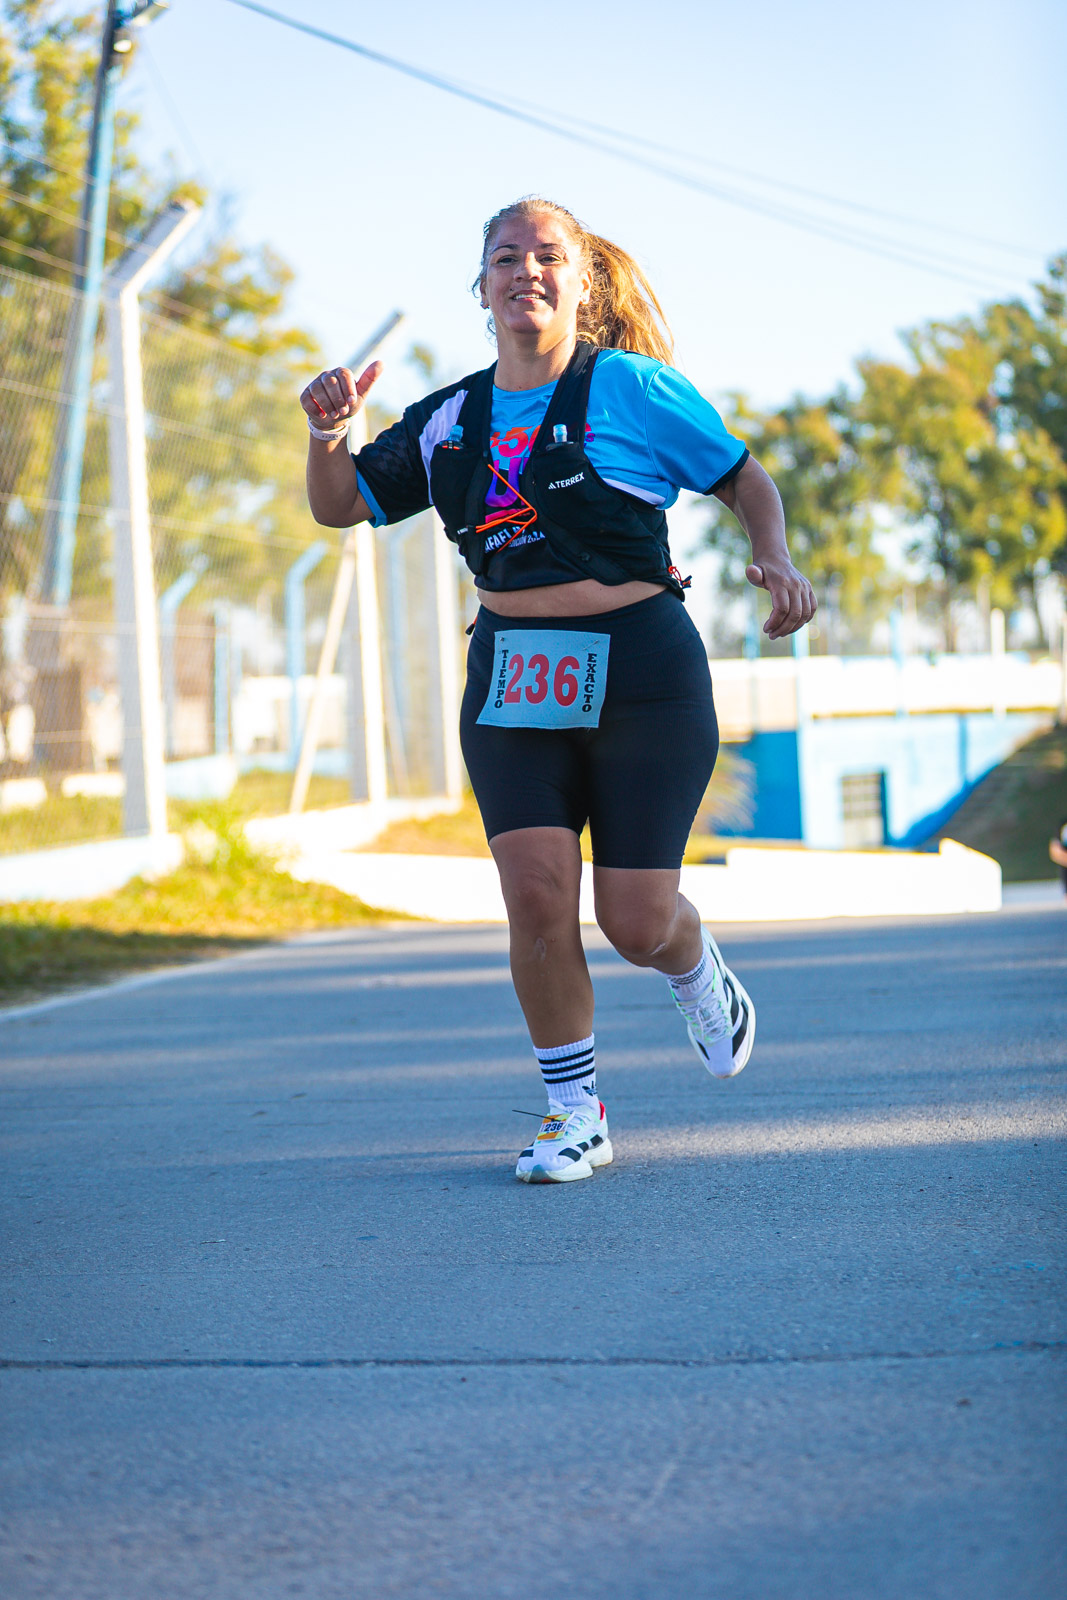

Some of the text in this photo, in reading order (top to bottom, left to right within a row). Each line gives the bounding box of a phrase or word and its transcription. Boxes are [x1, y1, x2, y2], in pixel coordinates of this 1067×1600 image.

[555, 471, 585, 489] TERREX
[494, 649, 509, 709] TIEMPO
[503, 653, 580, 707] 236
[581, 652, 598, 713] EXACTO
[544, 1122, 563, 1132] 236
